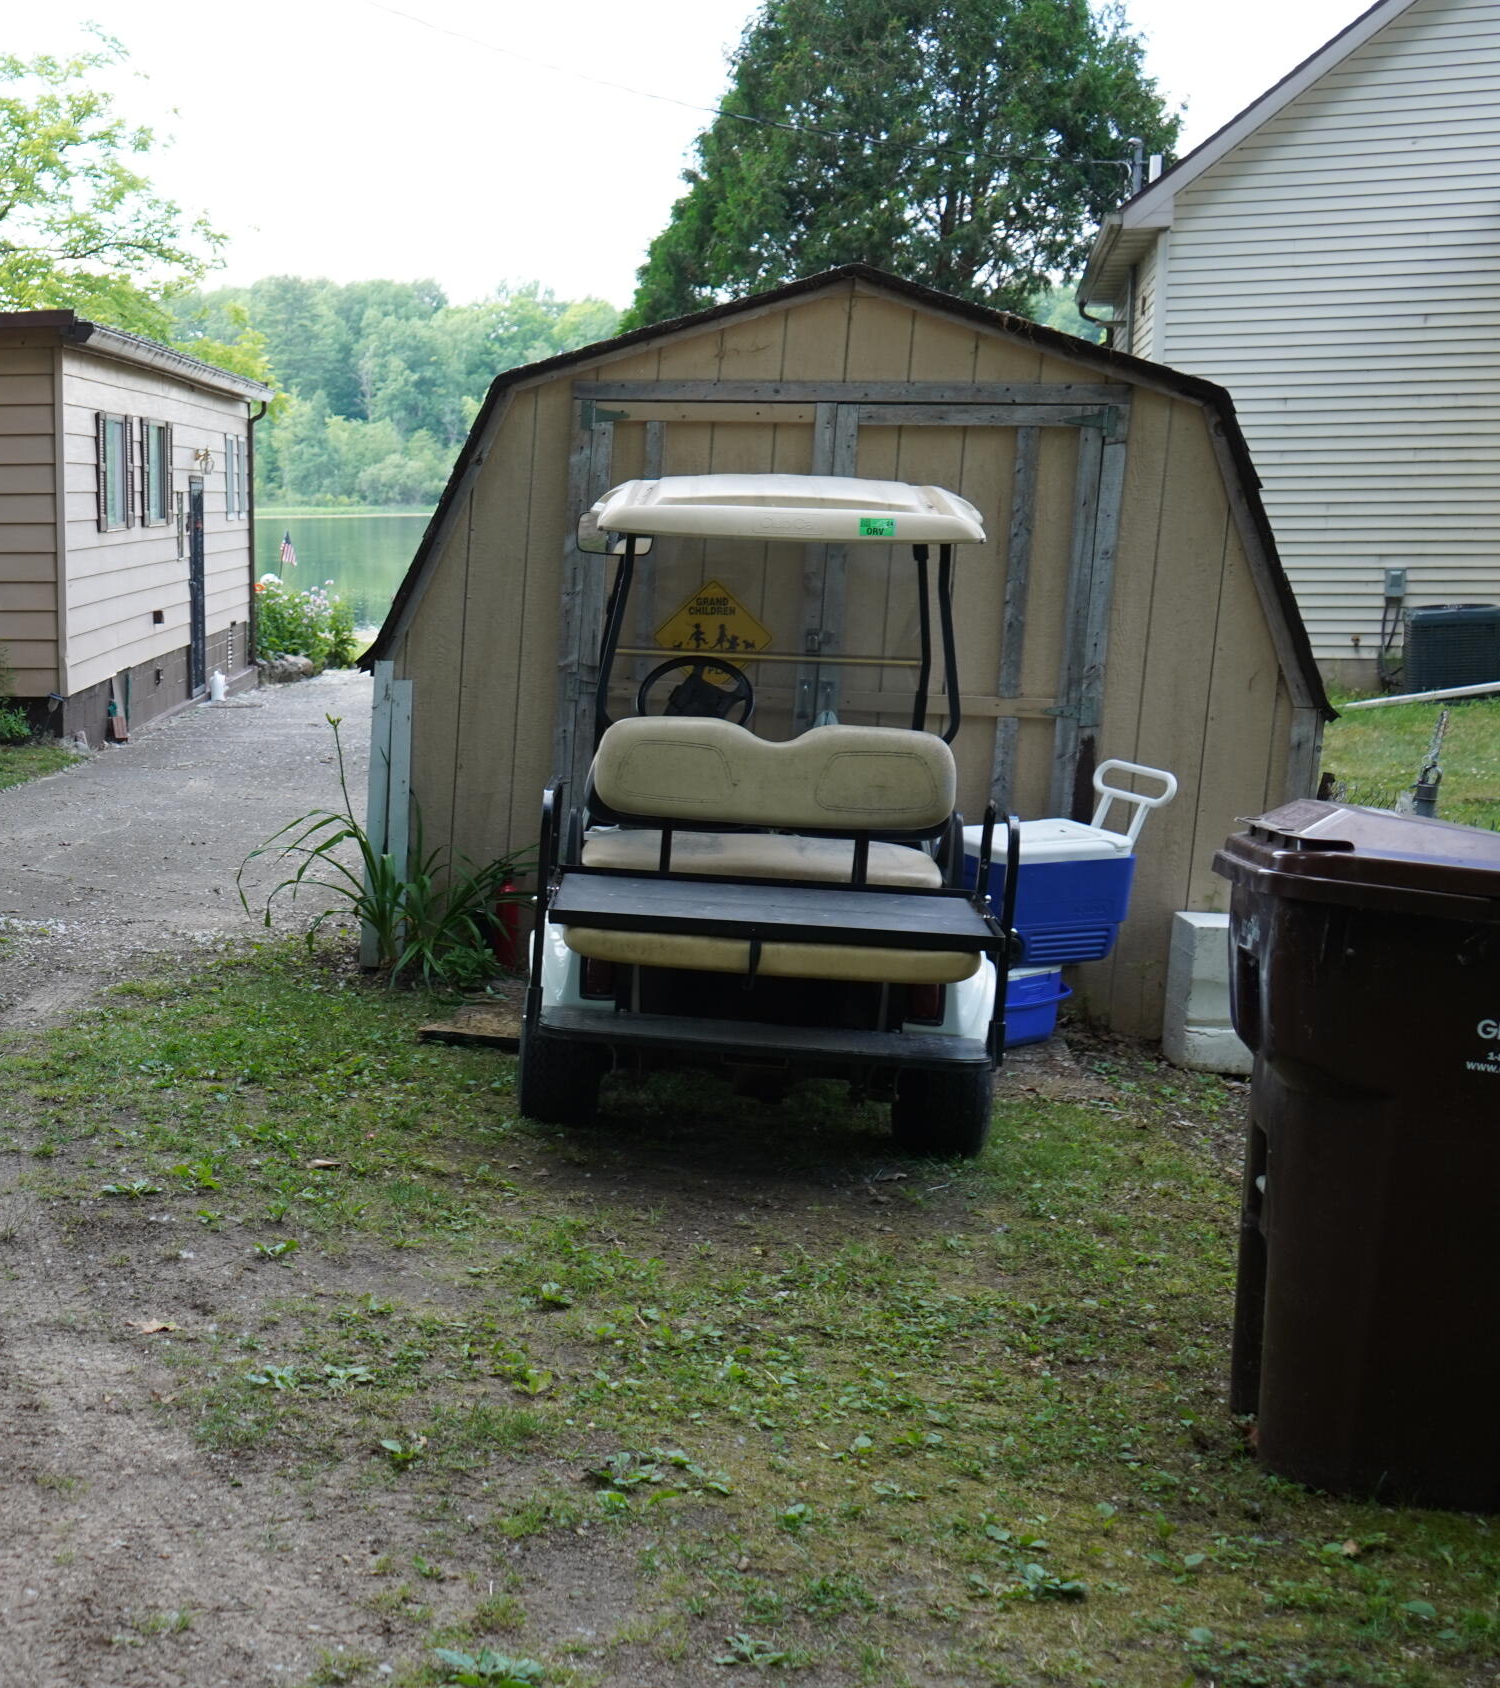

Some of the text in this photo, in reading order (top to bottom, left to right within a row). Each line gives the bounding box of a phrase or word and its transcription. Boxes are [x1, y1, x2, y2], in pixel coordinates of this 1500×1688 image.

[866, 527, 885, 536] ORV
[695, 596, 730, 606] GRAND
[688, 606, 736, 616] CHILDREN
[1476, 1018, 1500, 1041] G
[1465, 1060, 1500, 1074] www.
